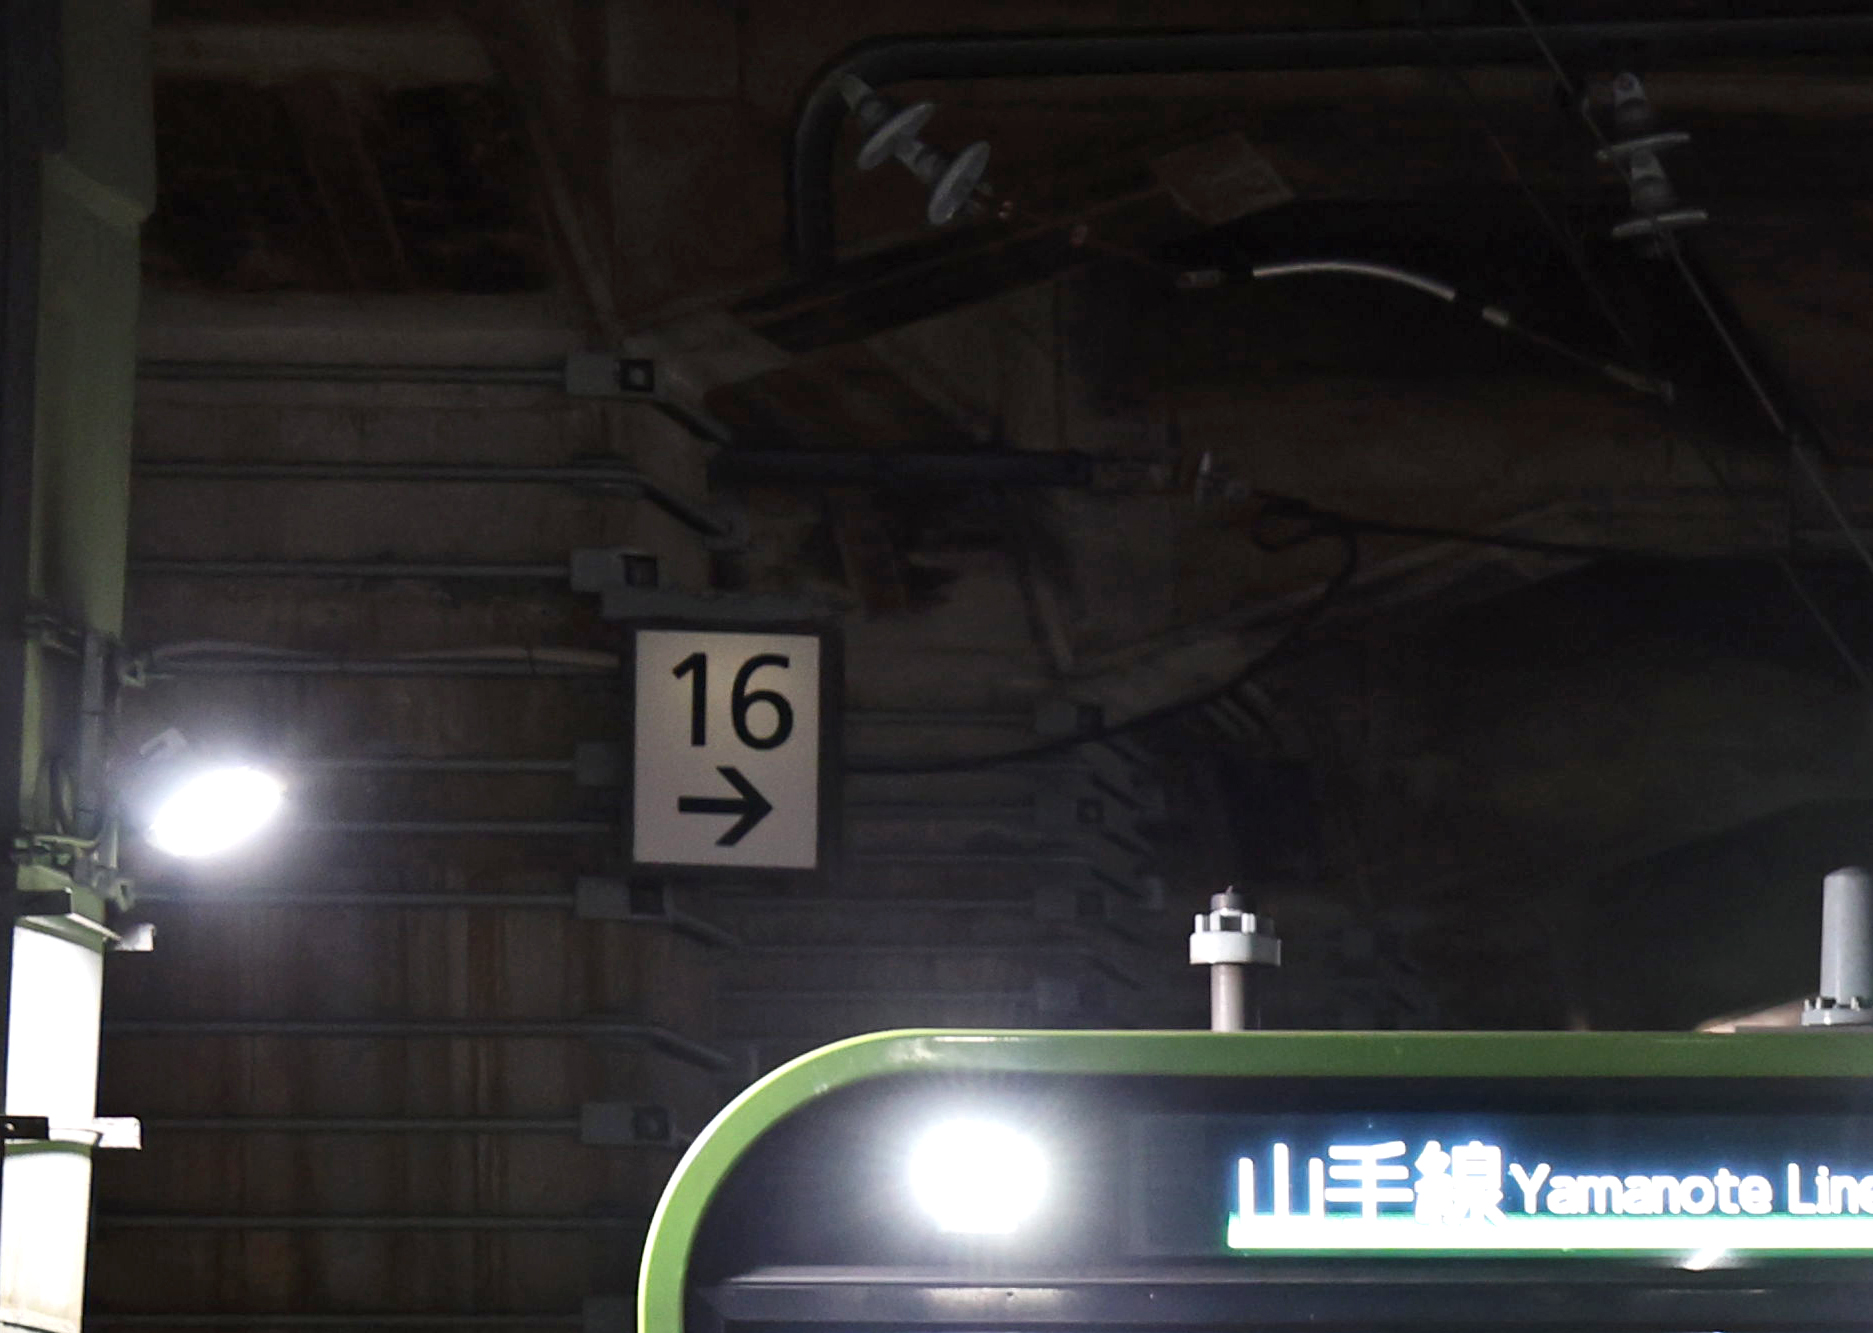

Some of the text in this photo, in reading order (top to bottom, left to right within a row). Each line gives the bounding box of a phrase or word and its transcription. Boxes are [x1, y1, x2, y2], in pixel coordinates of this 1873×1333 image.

[673, 651, 793, 750] 16
[1238, 1141, 1505, 1226] 山手線
[1510, 1162, 1772, 1215] Yamanote
